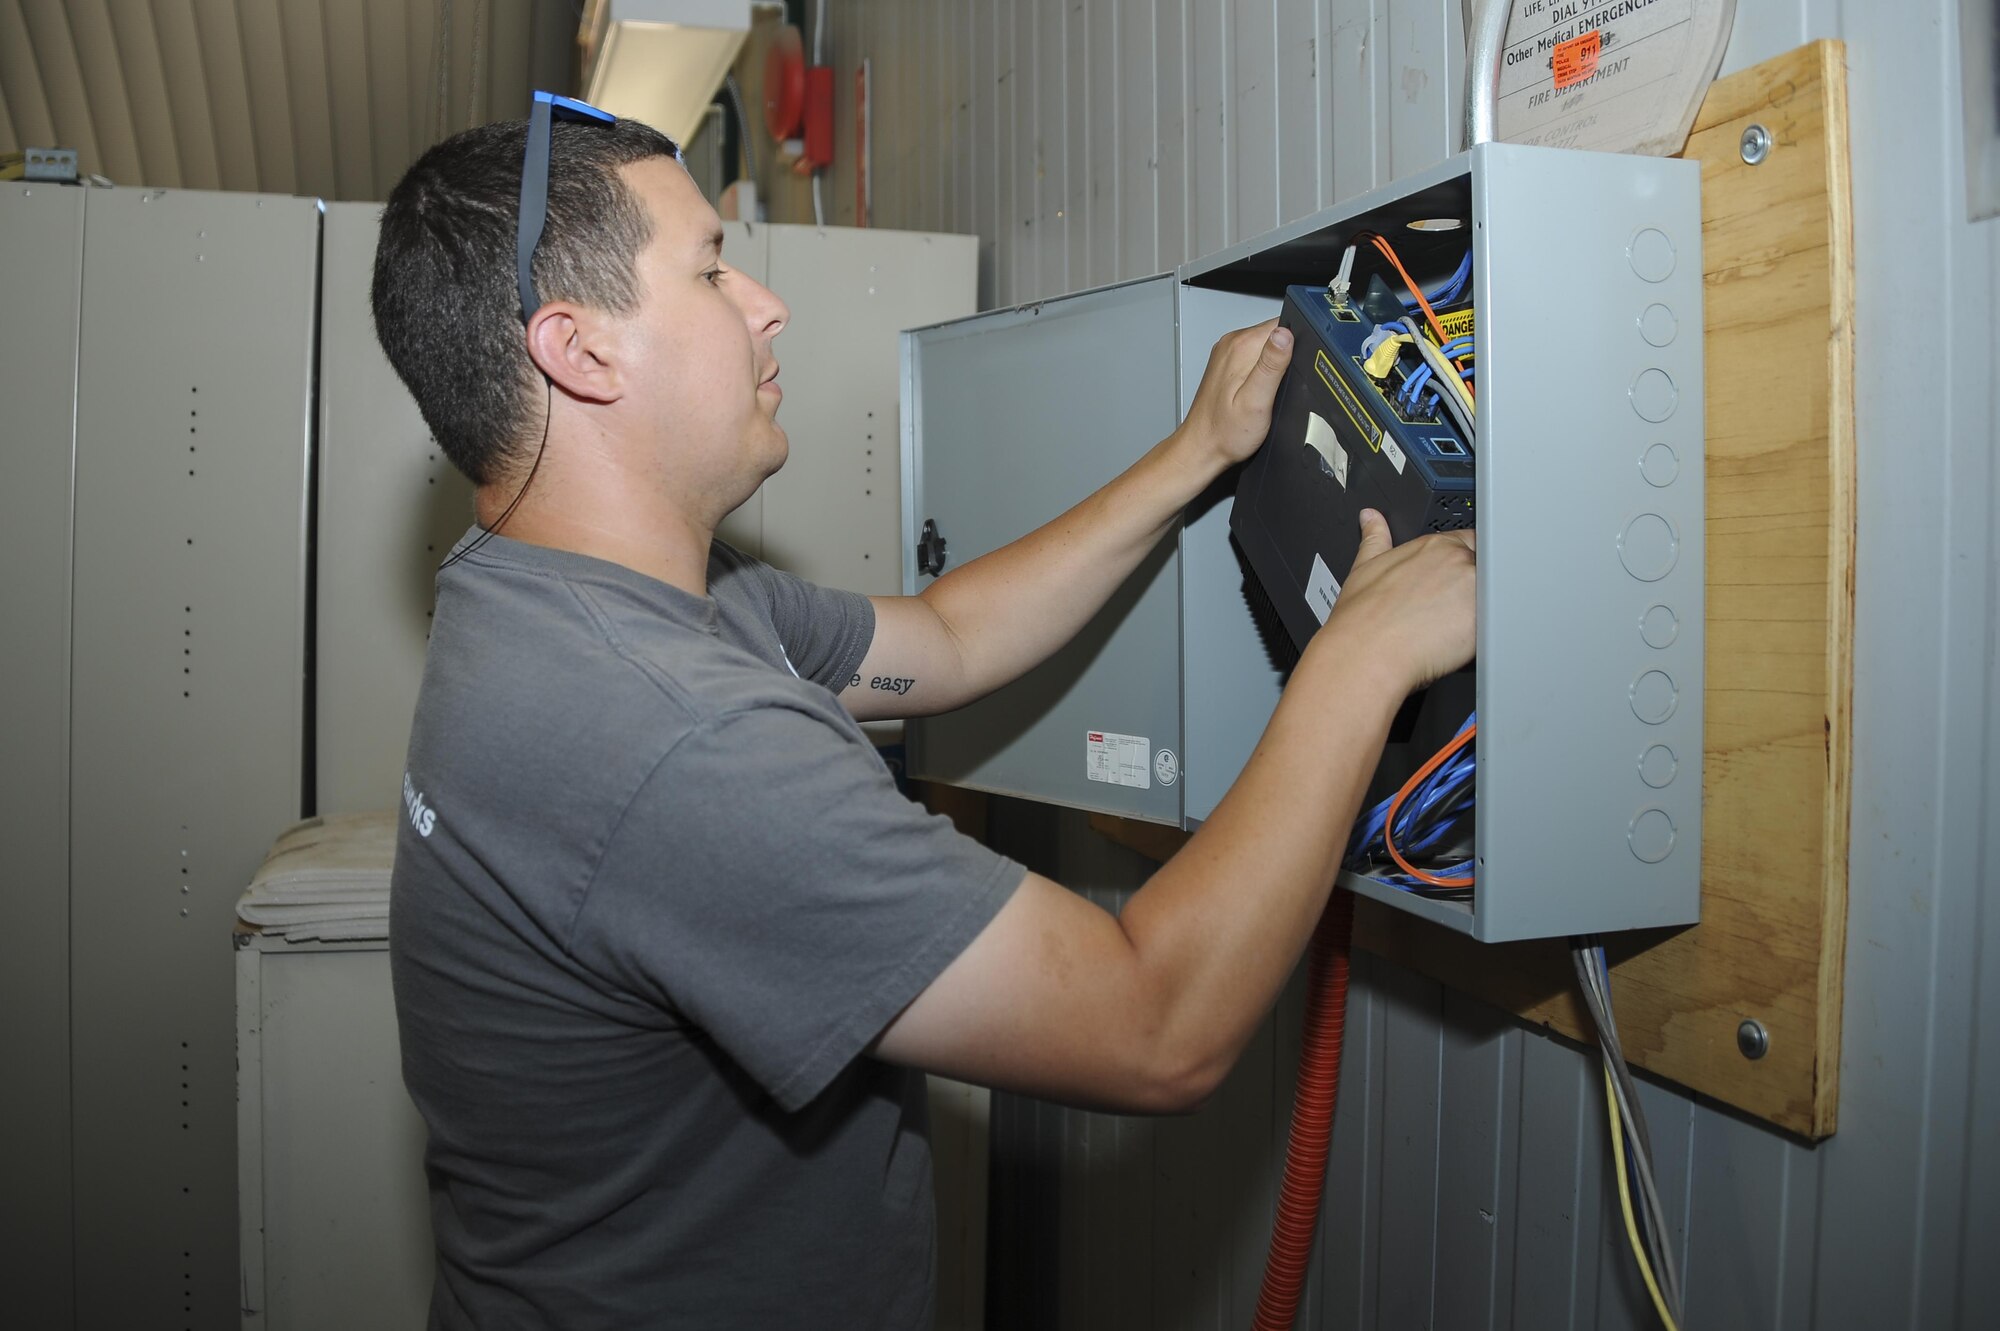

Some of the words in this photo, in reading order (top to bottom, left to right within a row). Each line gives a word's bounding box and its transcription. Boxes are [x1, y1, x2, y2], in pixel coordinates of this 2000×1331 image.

[1524, 1, 1545, 18] LIFE,
[1553, 2, 1578, 23] DIAL
[1507, 47, 1534, 66] Other
[1538, 25, 1574, 53] Medical
[1580, 44, 1597, 62] 911
[1528, 89, 1551, 109] FIRE
[1442, 319, 1474, 337] DANGE
[870, 676, 915, 696] easy
